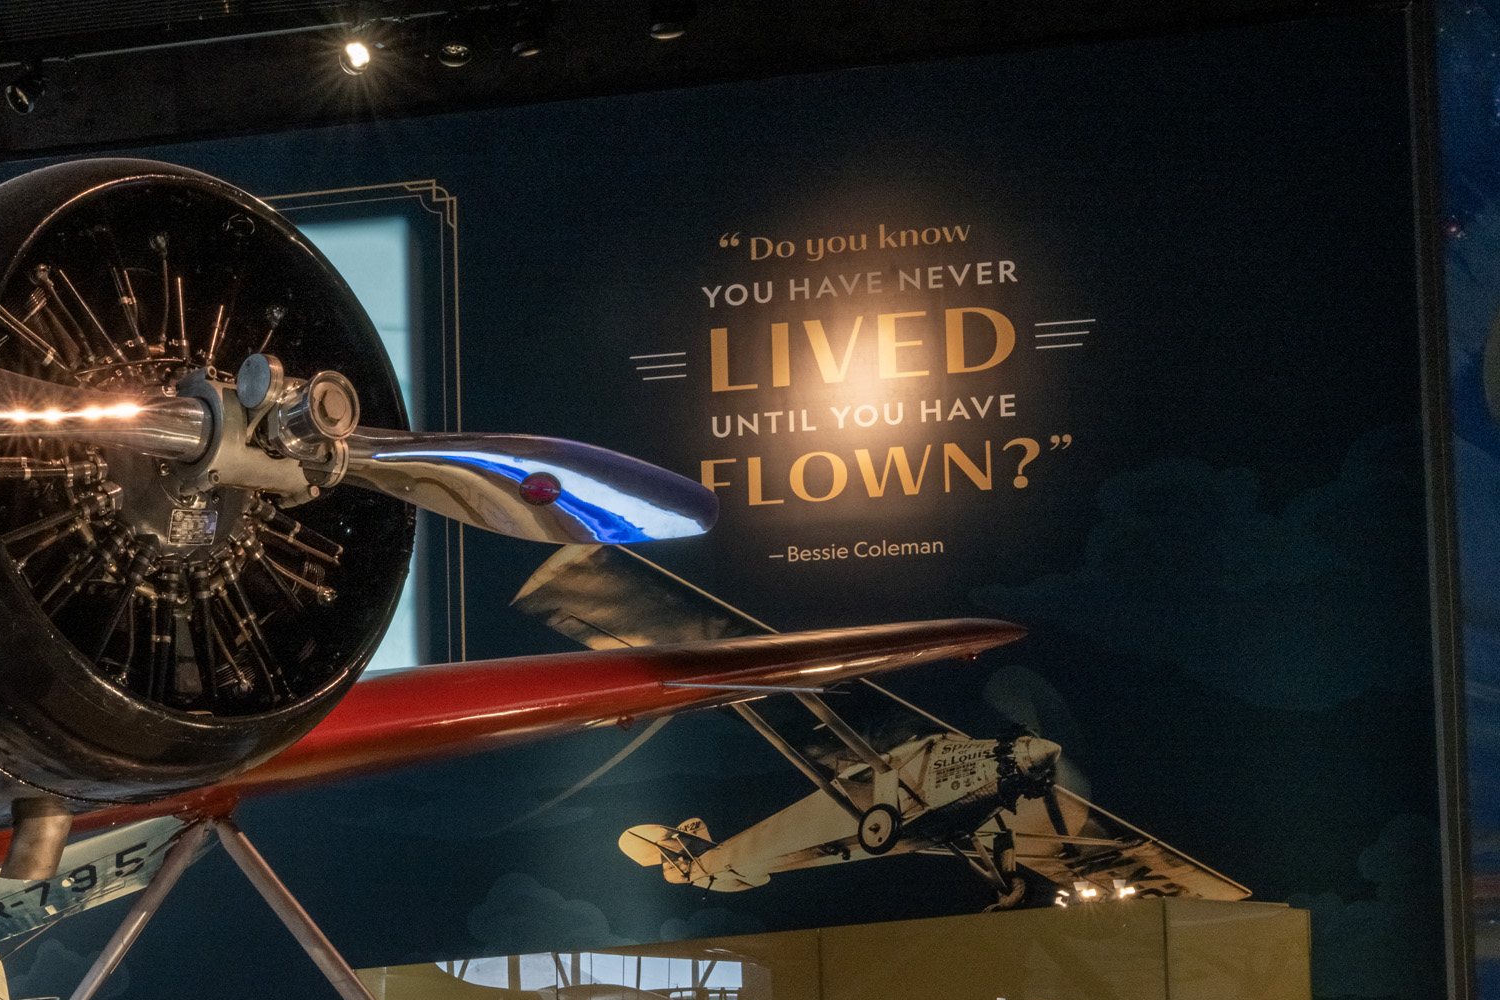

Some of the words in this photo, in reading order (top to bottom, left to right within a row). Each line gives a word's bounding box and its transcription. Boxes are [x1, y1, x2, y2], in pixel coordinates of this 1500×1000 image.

[806, 234, 867, 262] you
[878, 223, 971, 249] know
[701, 280, 773, 308] YOU
[790, 271, 882, 300] HAVE
[898, 260, 1018, 291] NEVER
[710, 306, 1016, 393] LIVED
[711, 409, 817, 438] UNTIL
[830, 401, 904, 429] YOU
[920, 393, 1017, 423] HAVE
[853, 540, 944, 560] Coleman
